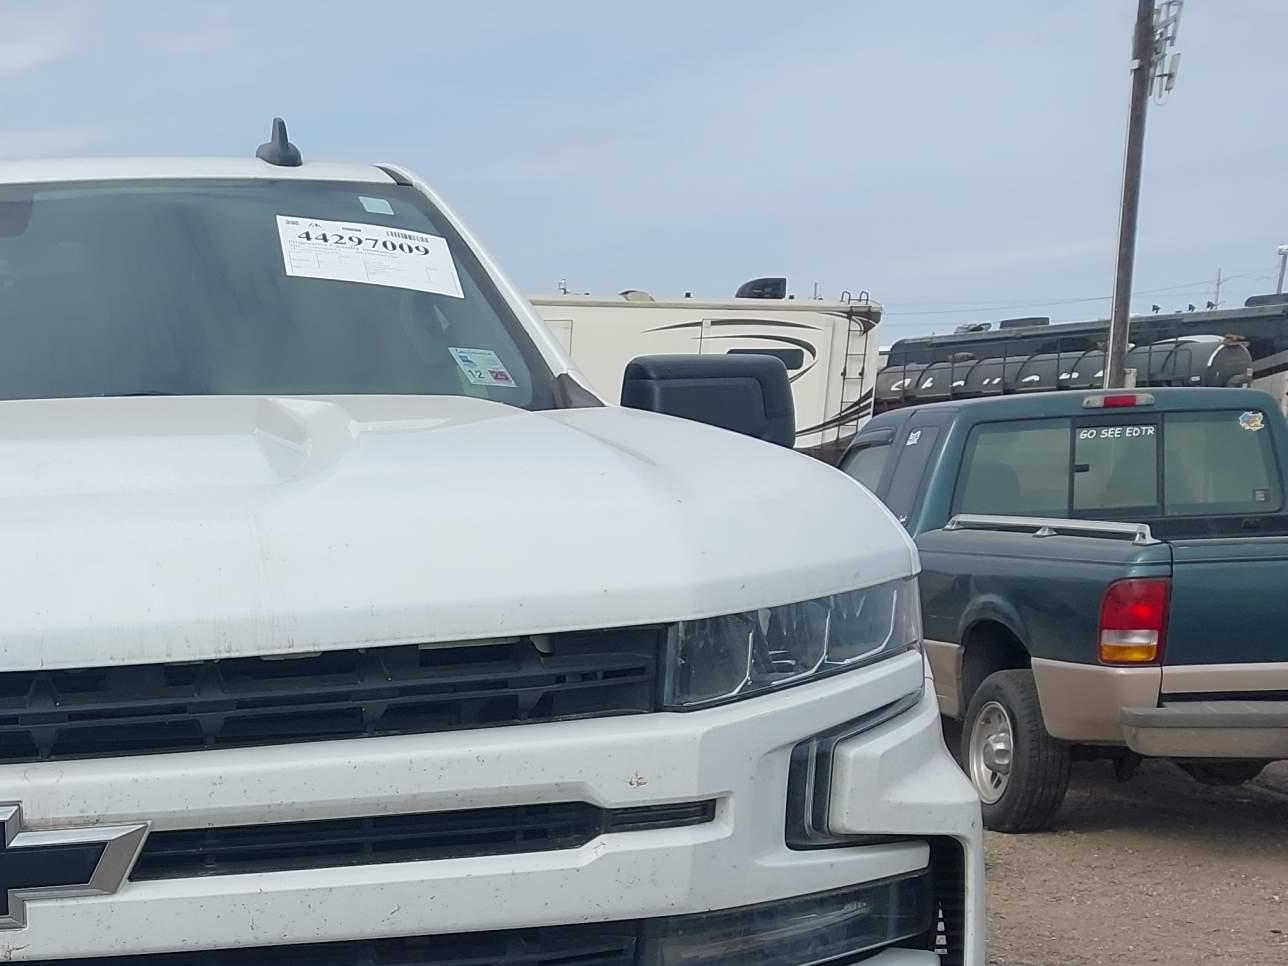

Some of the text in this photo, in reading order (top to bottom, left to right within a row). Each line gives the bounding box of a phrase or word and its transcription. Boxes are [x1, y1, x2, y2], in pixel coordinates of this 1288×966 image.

[297, 230, 430, 256] 44297009
[468, 369, 485, 378] 12
[1079, 425, 1155, 439] GO SEE EDTR
